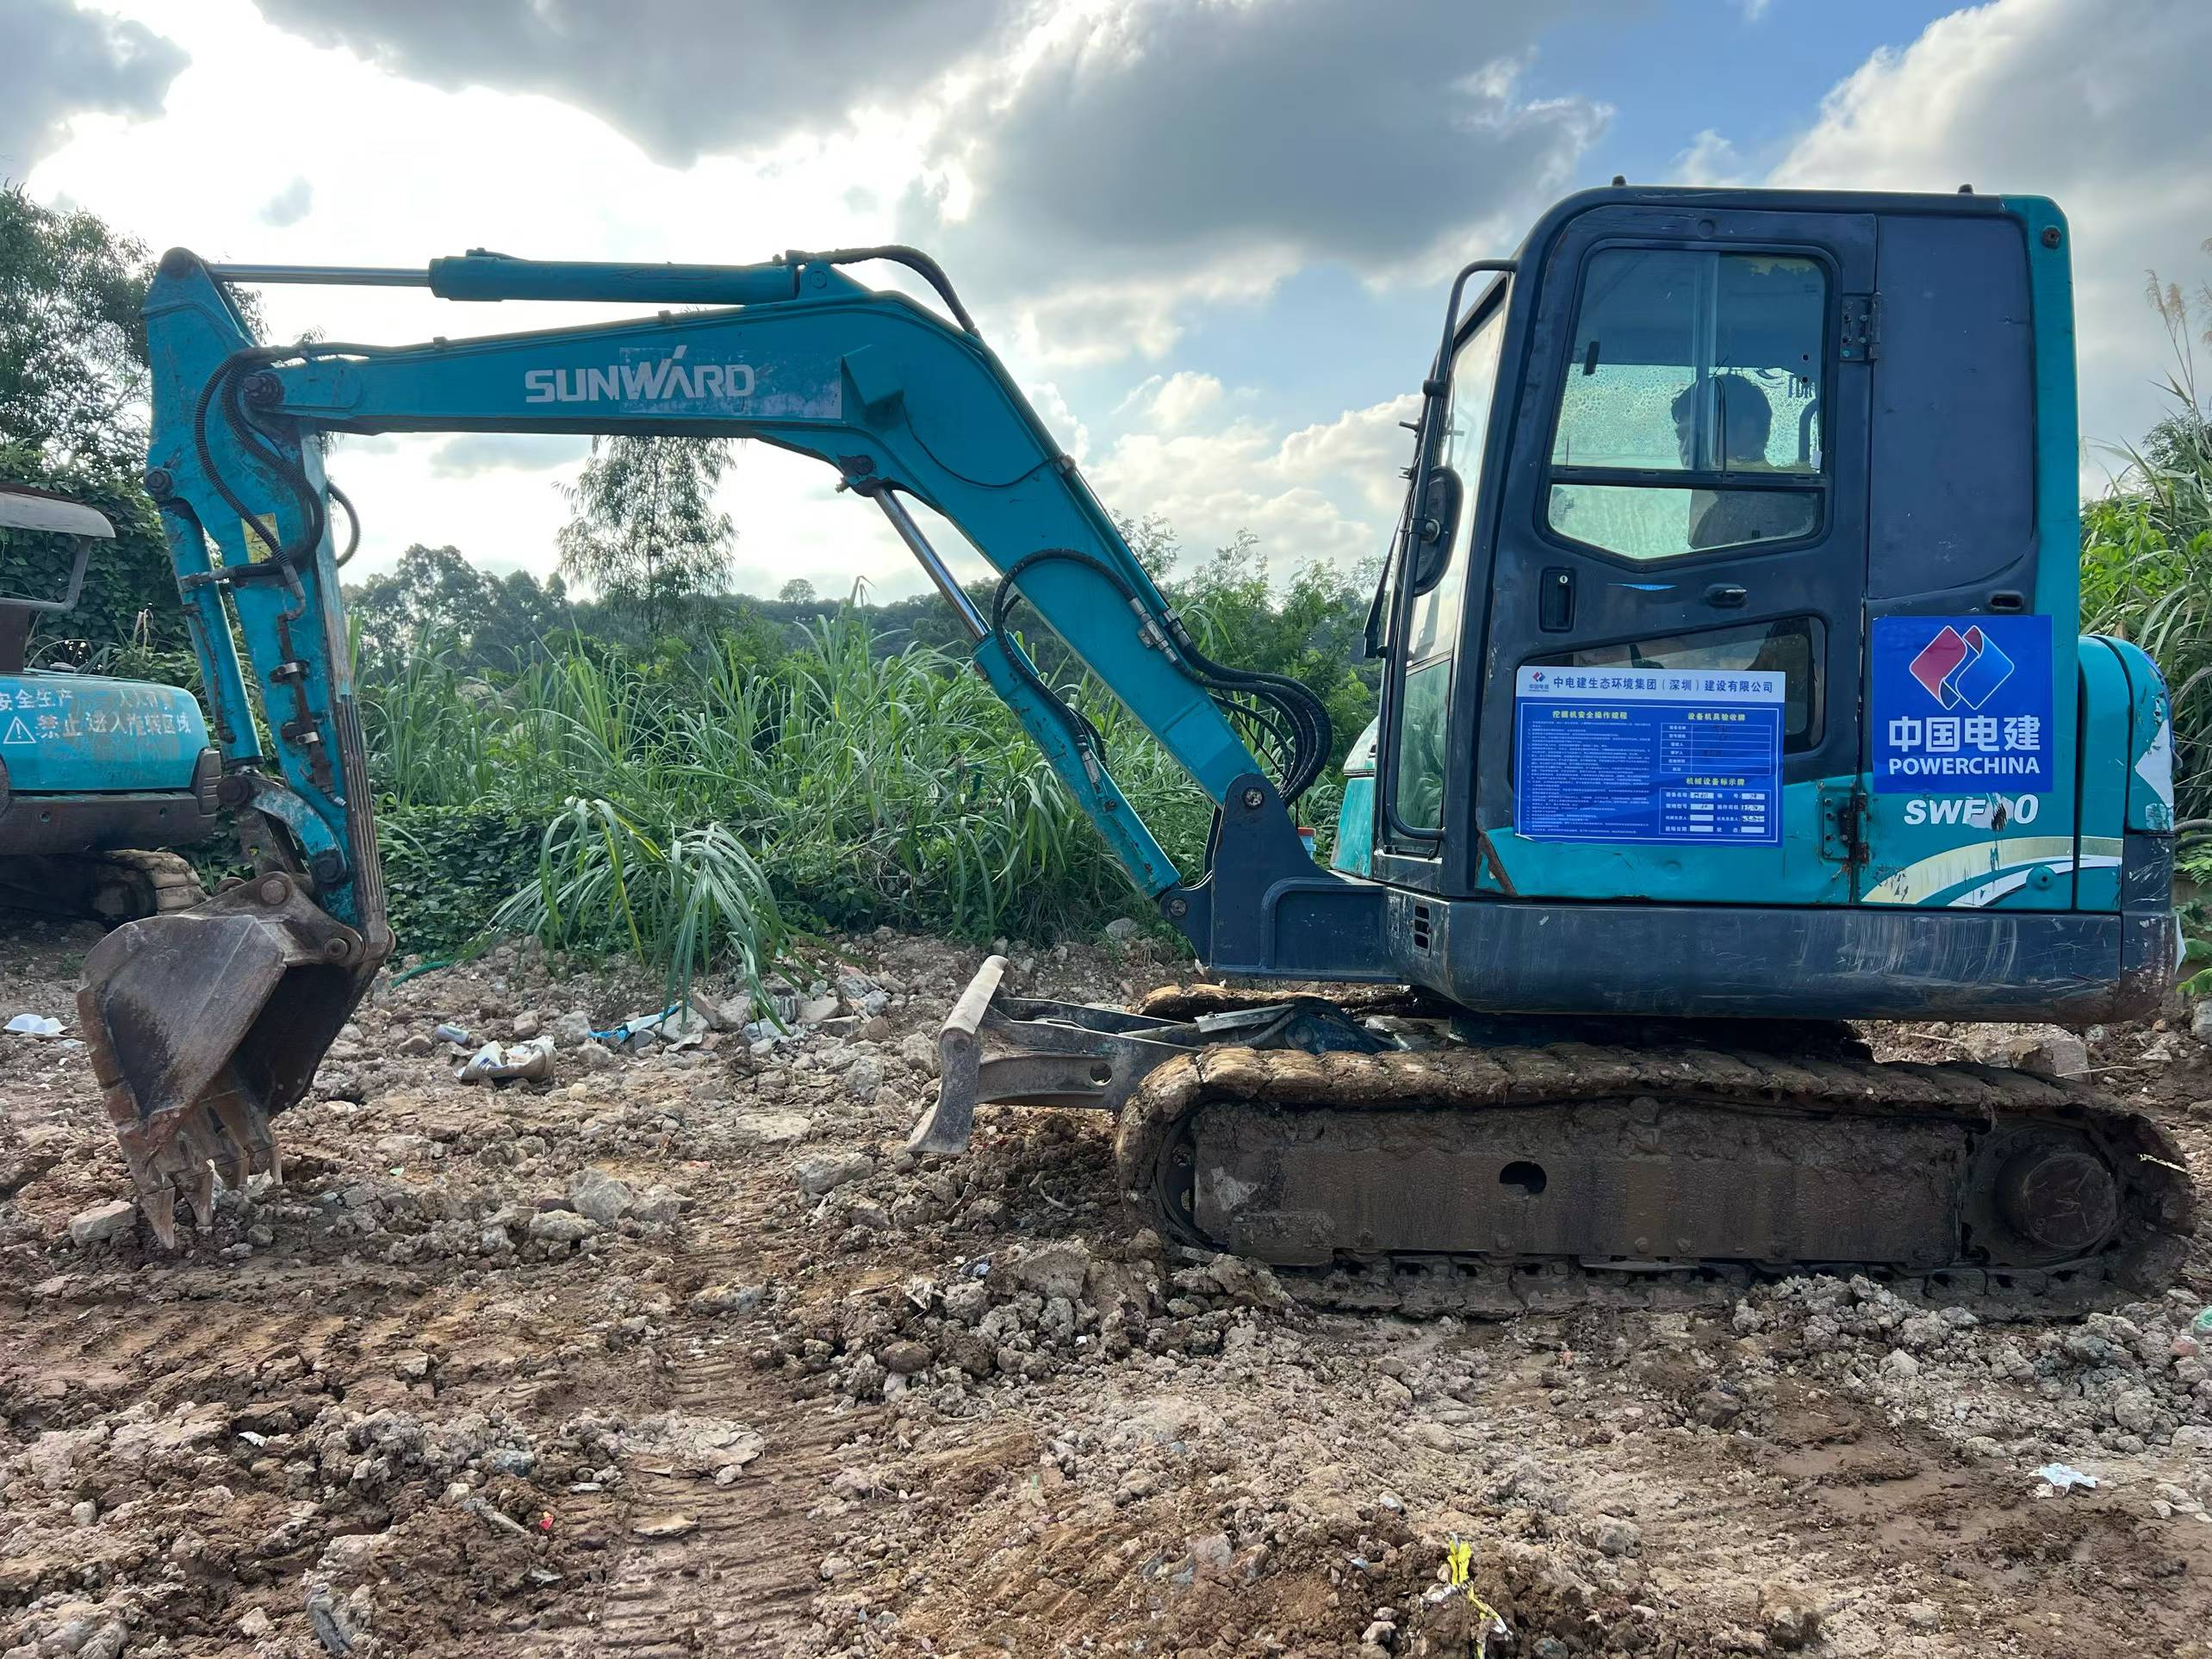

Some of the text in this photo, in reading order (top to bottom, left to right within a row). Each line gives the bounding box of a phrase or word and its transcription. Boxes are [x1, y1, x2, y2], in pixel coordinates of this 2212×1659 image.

[525, 345, 755, 402] SUNWARD
[1889, 715, 2041, 752] 中国电建
[1889, 757, 2041, 774] POWERCHINA
[1904, 793, 2039, 825] SWE0
